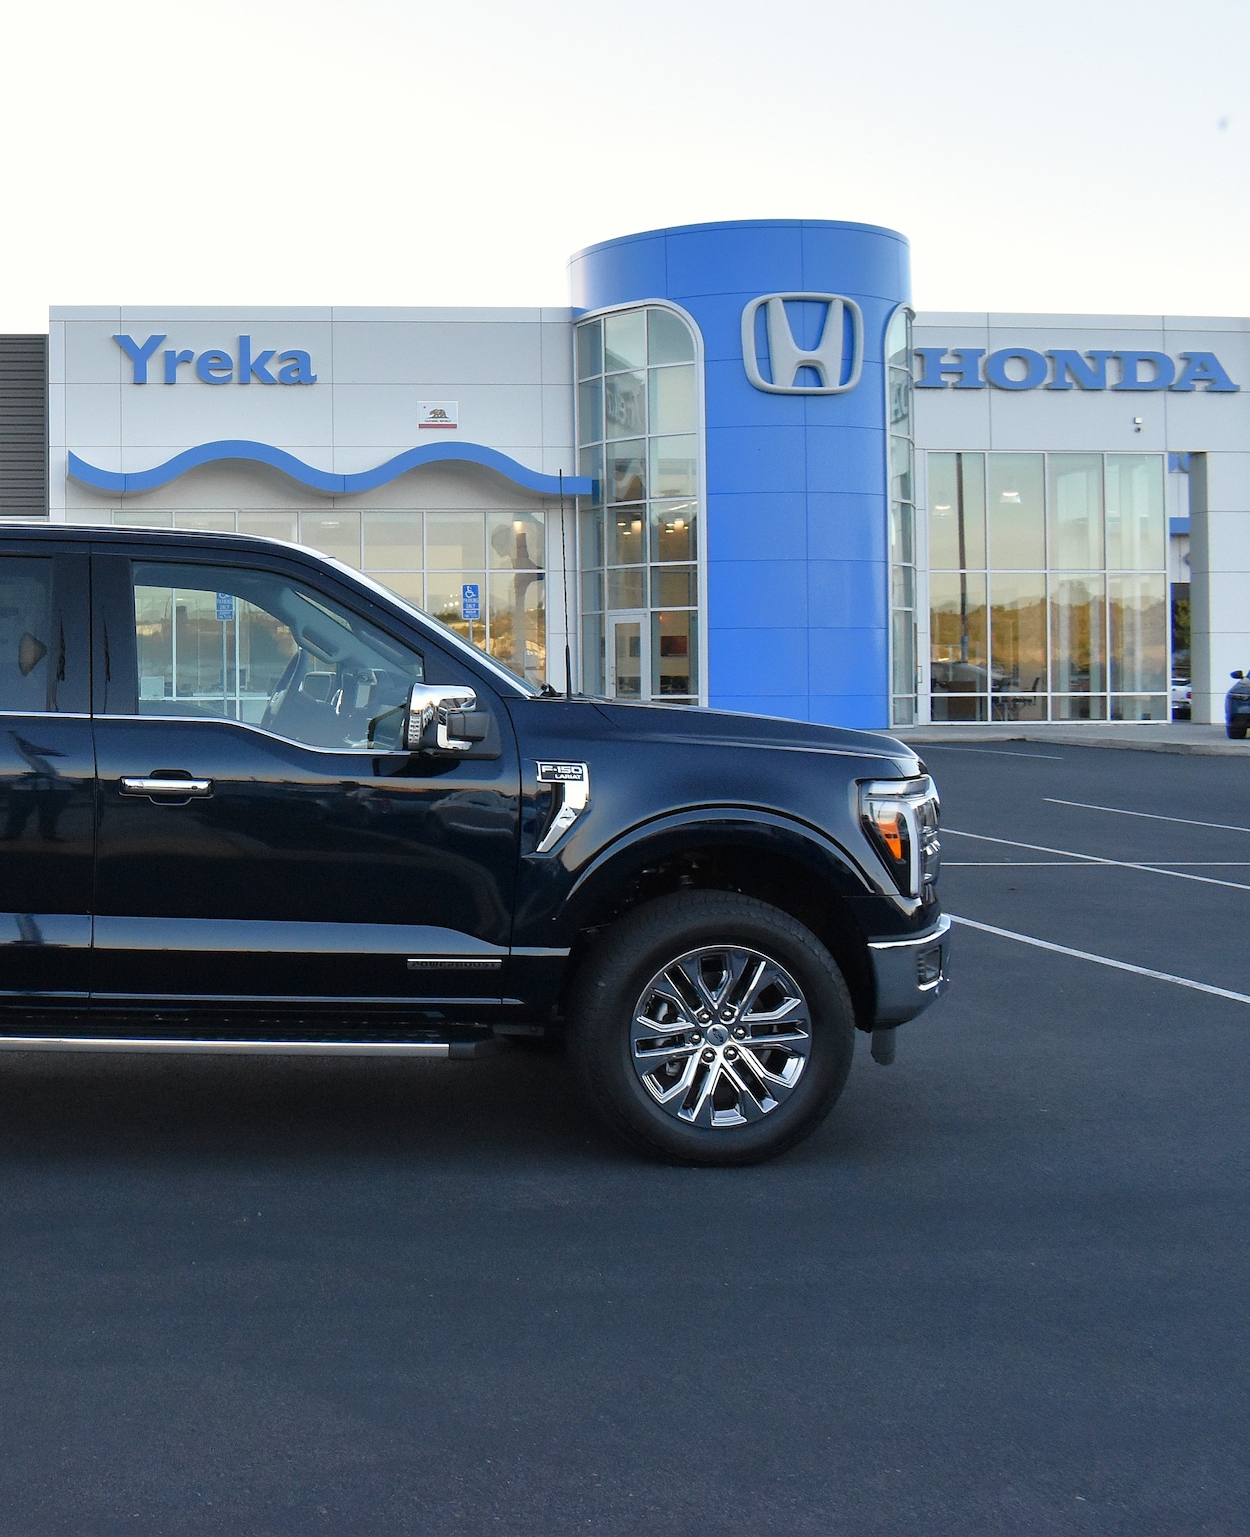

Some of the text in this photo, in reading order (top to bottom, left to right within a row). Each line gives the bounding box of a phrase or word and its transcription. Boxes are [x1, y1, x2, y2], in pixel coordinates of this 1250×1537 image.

[112, 334, 318, 385] Yreka
[914, 347, 1241, 392] HONDA
[541, 765, 583, 774] F-150
